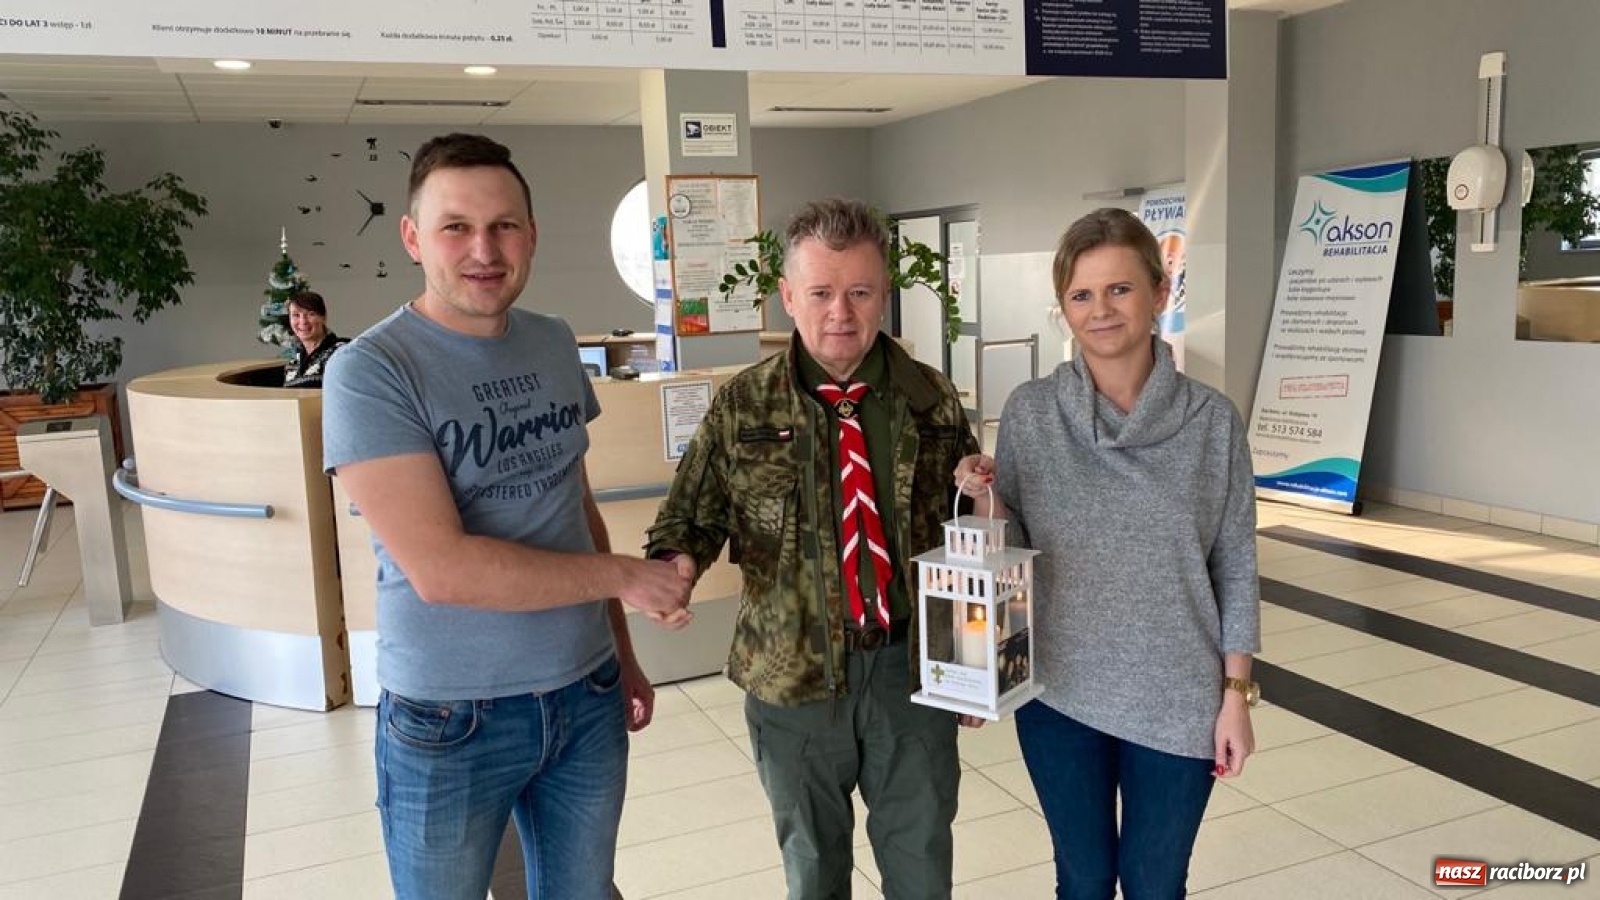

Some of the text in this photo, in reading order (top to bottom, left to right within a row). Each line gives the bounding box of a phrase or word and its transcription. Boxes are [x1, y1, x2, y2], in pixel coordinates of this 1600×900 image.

[25, 19, 40, 27] LAT
[50, 21, 74, 30] wstęp
[175, 26, 212, 34] otrzymuje
[213, 26, 255, 34] dodatkowo
[267, 28, 292, 36] MINUT
[304, 29, 340, 38] przebranie
[703, 124, 732, 132] OBIEKT
[1326, 214, 1393, 243] akson
[1323, 245, 1388, 257] REHABILITACJA
[471, 372, 543, 402] GREATEST
[1271, 424, 1287, 434] 513
[1288, 426, 1304, 436] 574
[1307, 428, 1323, 438] 584
[436, 402, 582, 477] Warrior
[497, 456, 518, 475] LOS
[519, 443, 563, 467] ANGELES
